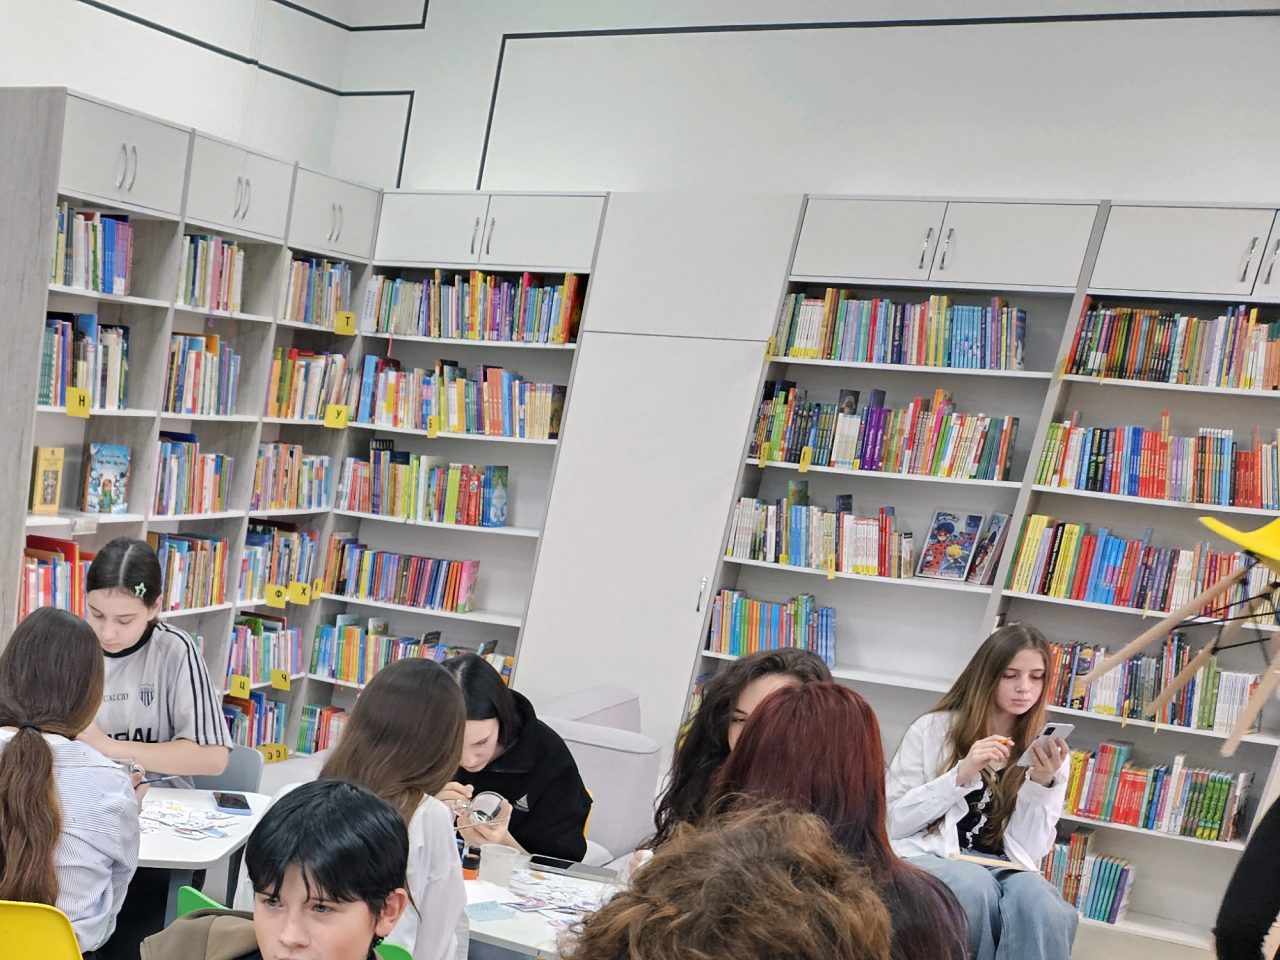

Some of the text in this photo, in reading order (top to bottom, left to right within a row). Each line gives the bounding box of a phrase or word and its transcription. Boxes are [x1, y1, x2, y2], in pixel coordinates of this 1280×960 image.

[344, 316, 351, 326] Т
[78, 395, 85, 406] Н
[301, 586, 306, 596] Х
[281, 674, 287, 682] Ч
[103, 692, 129, 702] CALCIO
